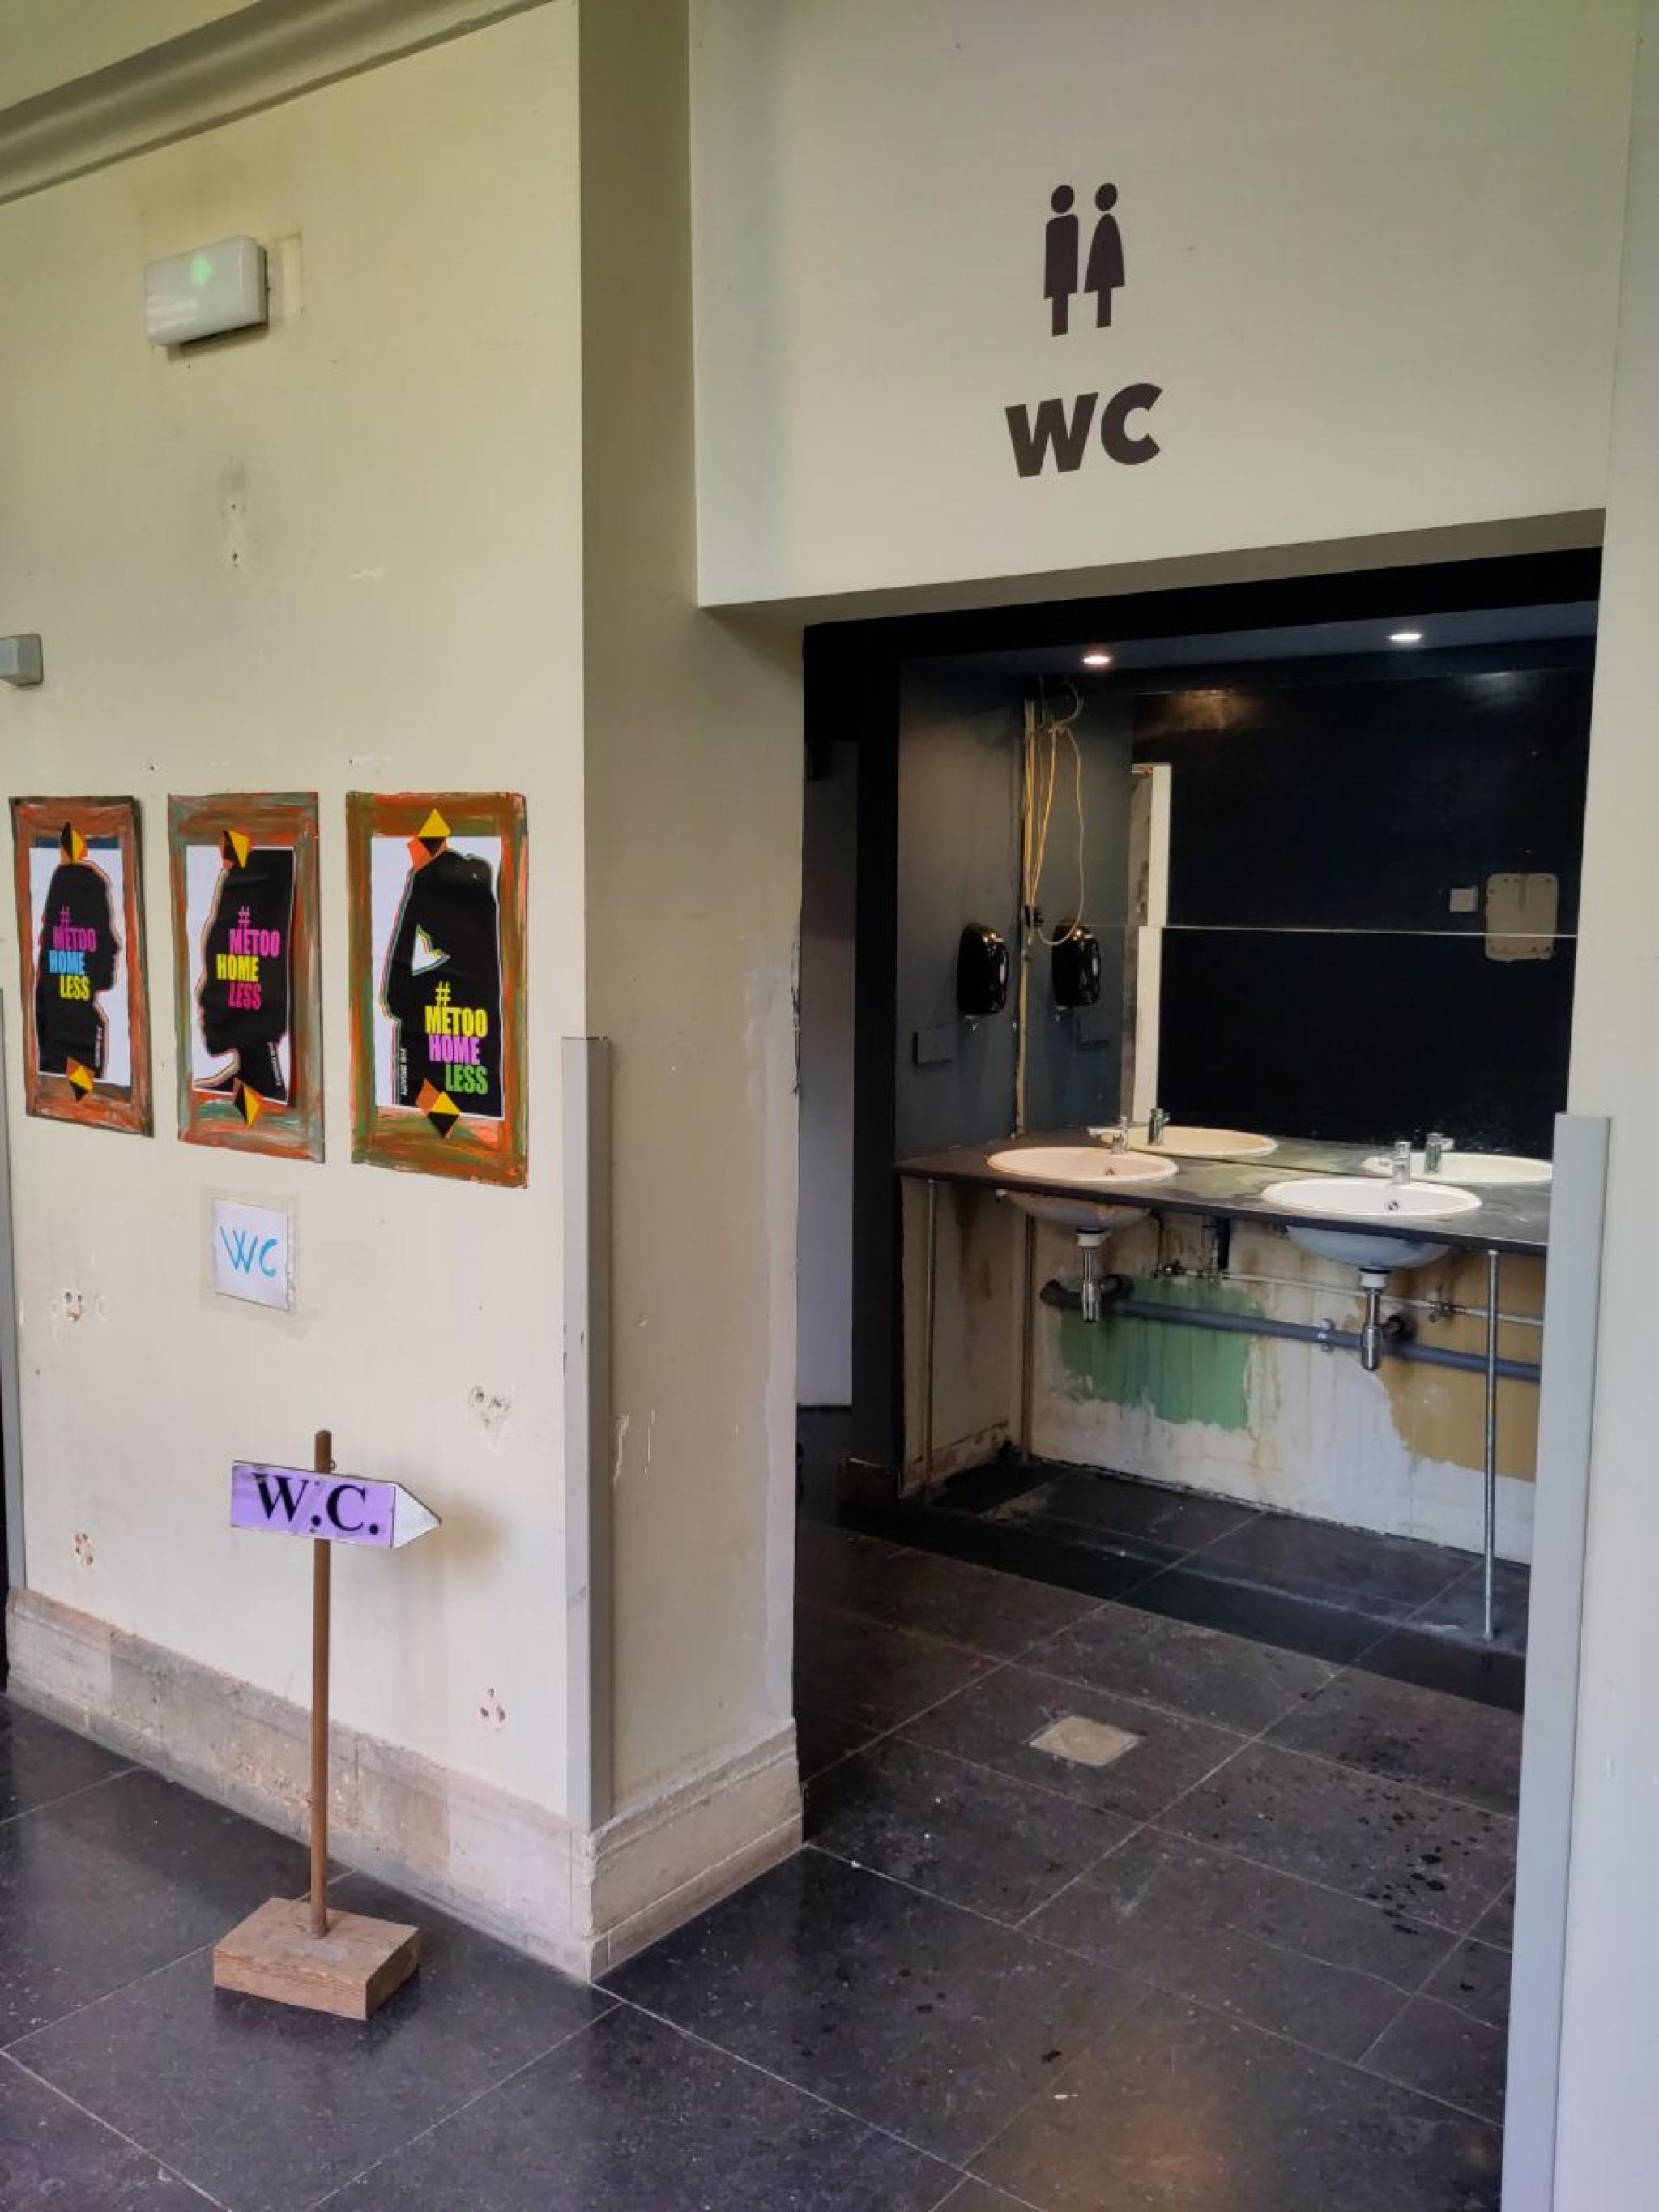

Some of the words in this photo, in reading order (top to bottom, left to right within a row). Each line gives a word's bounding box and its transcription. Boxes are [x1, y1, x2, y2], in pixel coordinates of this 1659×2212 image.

[1005, 382, 1162, 478] WC
[238, 905, 250, 929] #
[53, 926, 96, 952] METOO
[229, 928, 280, 958] METOO
[49, 950, 85, 976] HOME
[216, 953, 259, 982] HOME
[60, 974, 90, 1000] LESS
[228, 980, 262, 1010] LESS
[435, 981, 451, 1006] #
[424, 1006, 488, 1038] METOO
[429, 1034, 480, 1065] HOME
[445, 1064, 488, 1095] LESS
[219, 1225, 278, 1278] WC
[253, 1472, 380, 1535] W.C.
